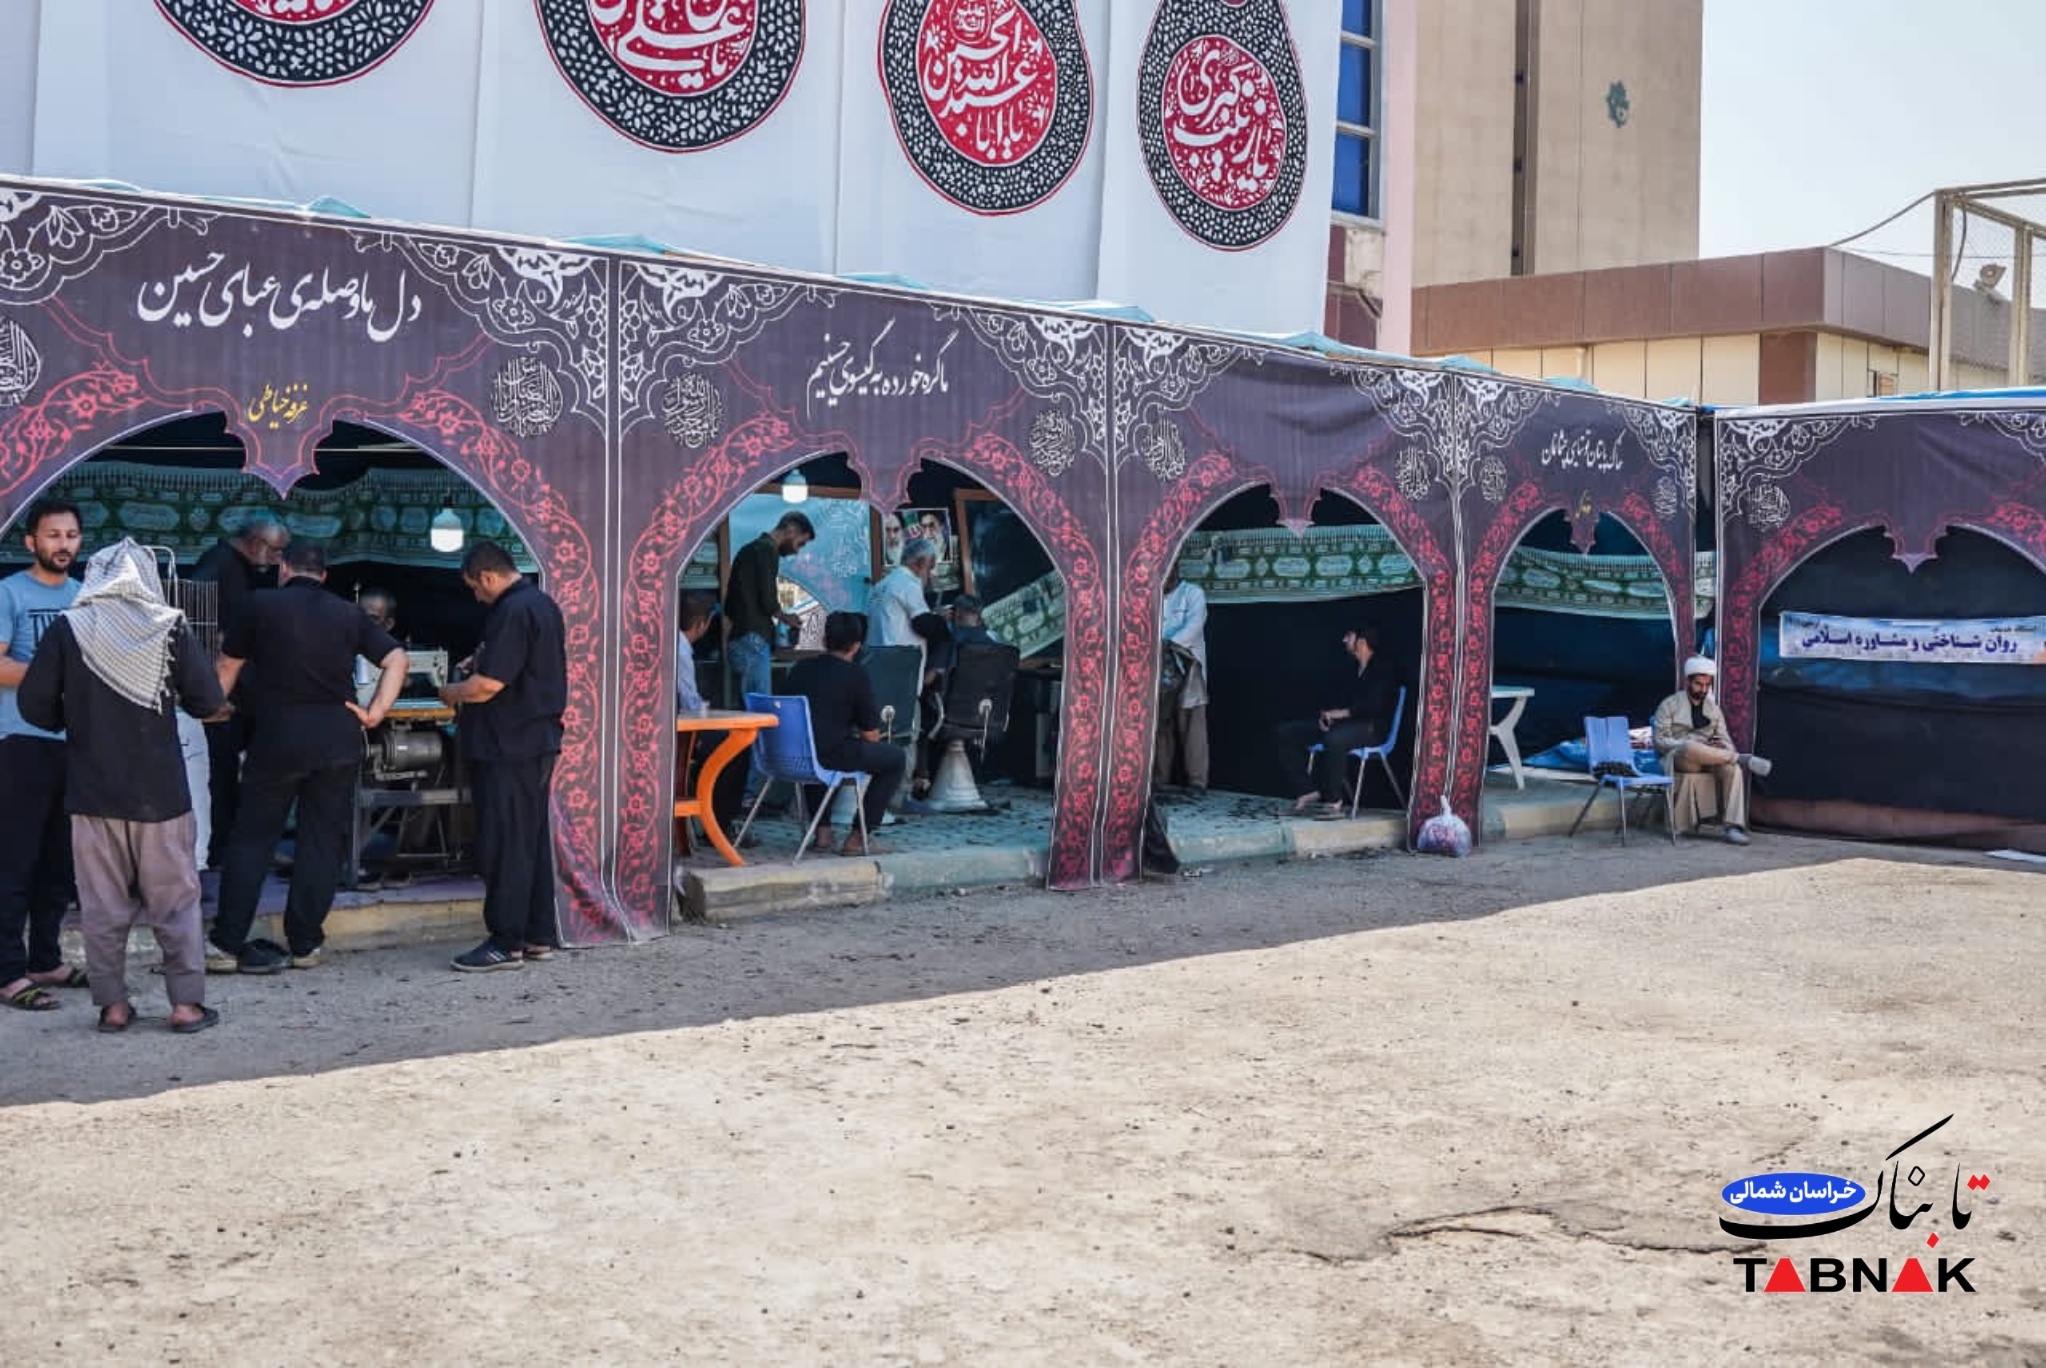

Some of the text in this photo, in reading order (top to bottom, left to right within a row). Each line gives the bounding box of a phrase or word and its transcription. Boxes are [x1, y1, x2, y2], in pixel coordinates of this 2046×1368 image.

[136, 251, 226, 328] حسین
[199, 261, 277, 338] عبای
[367, 269, 421, 343] دل
[247, 383, 291, 430] خیاطی
[1802, 626, 1852, 648] اسلامی
[1856, 632, 1909, 650] مشاوره
[1912, 638, 1919, 652] و
[1922, 628, 1982, 652] شناختی
[1985, 635, 2018, 653] روان
